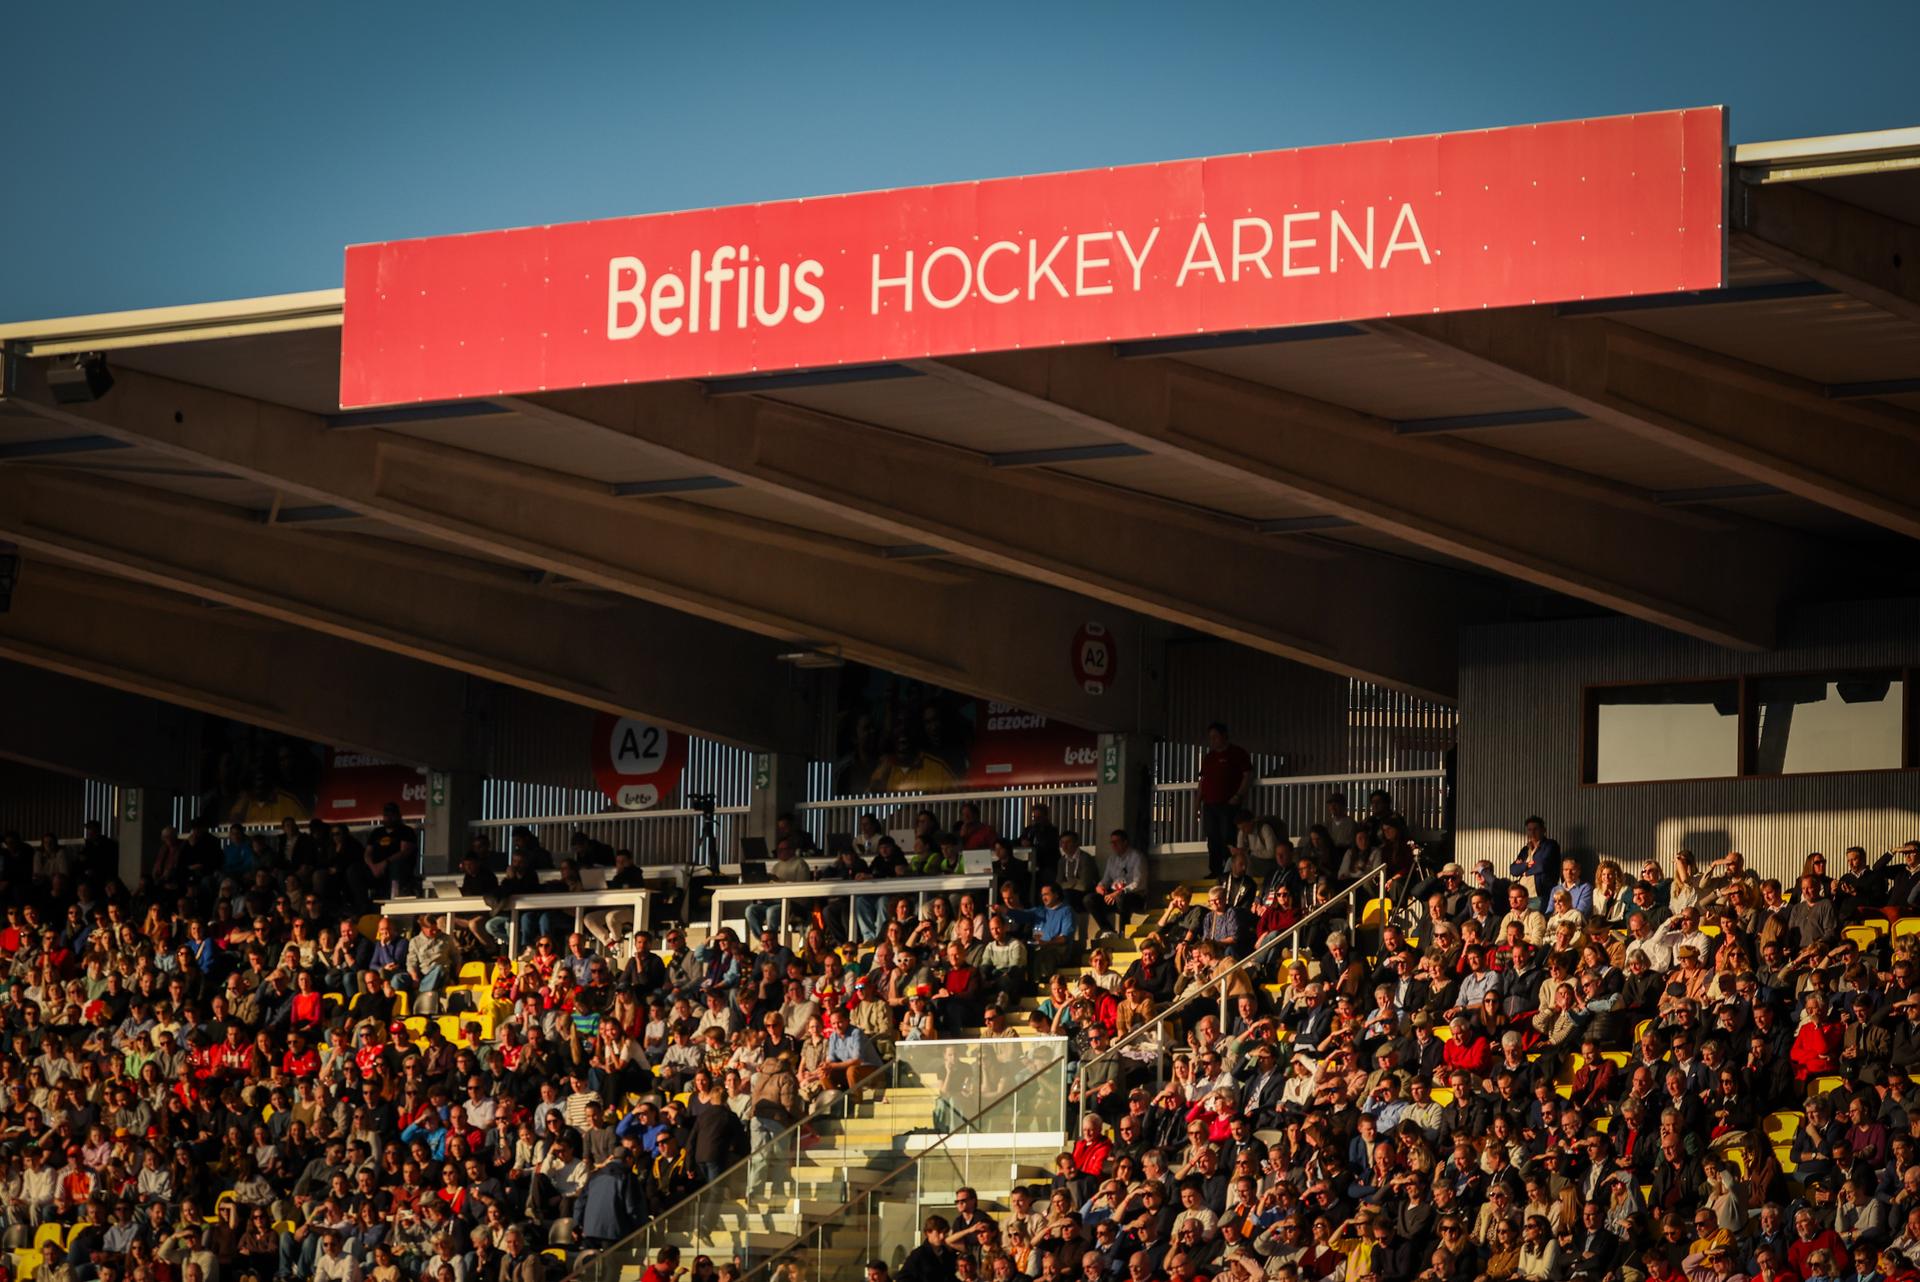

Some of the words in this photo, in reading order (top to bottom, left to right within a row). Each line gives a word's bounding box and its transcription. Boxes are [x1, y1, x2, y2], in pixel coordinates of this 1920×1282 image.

[607, 245, 825, 341] Belfius
[870, 227, 1161, 315] HOCKEY
[1175, 203, 1432, 288] ARENA
[1085, 648, 1105, 667] A2
[618, 727, 659, 760] A2
[402, 783, 427, 801] lott
